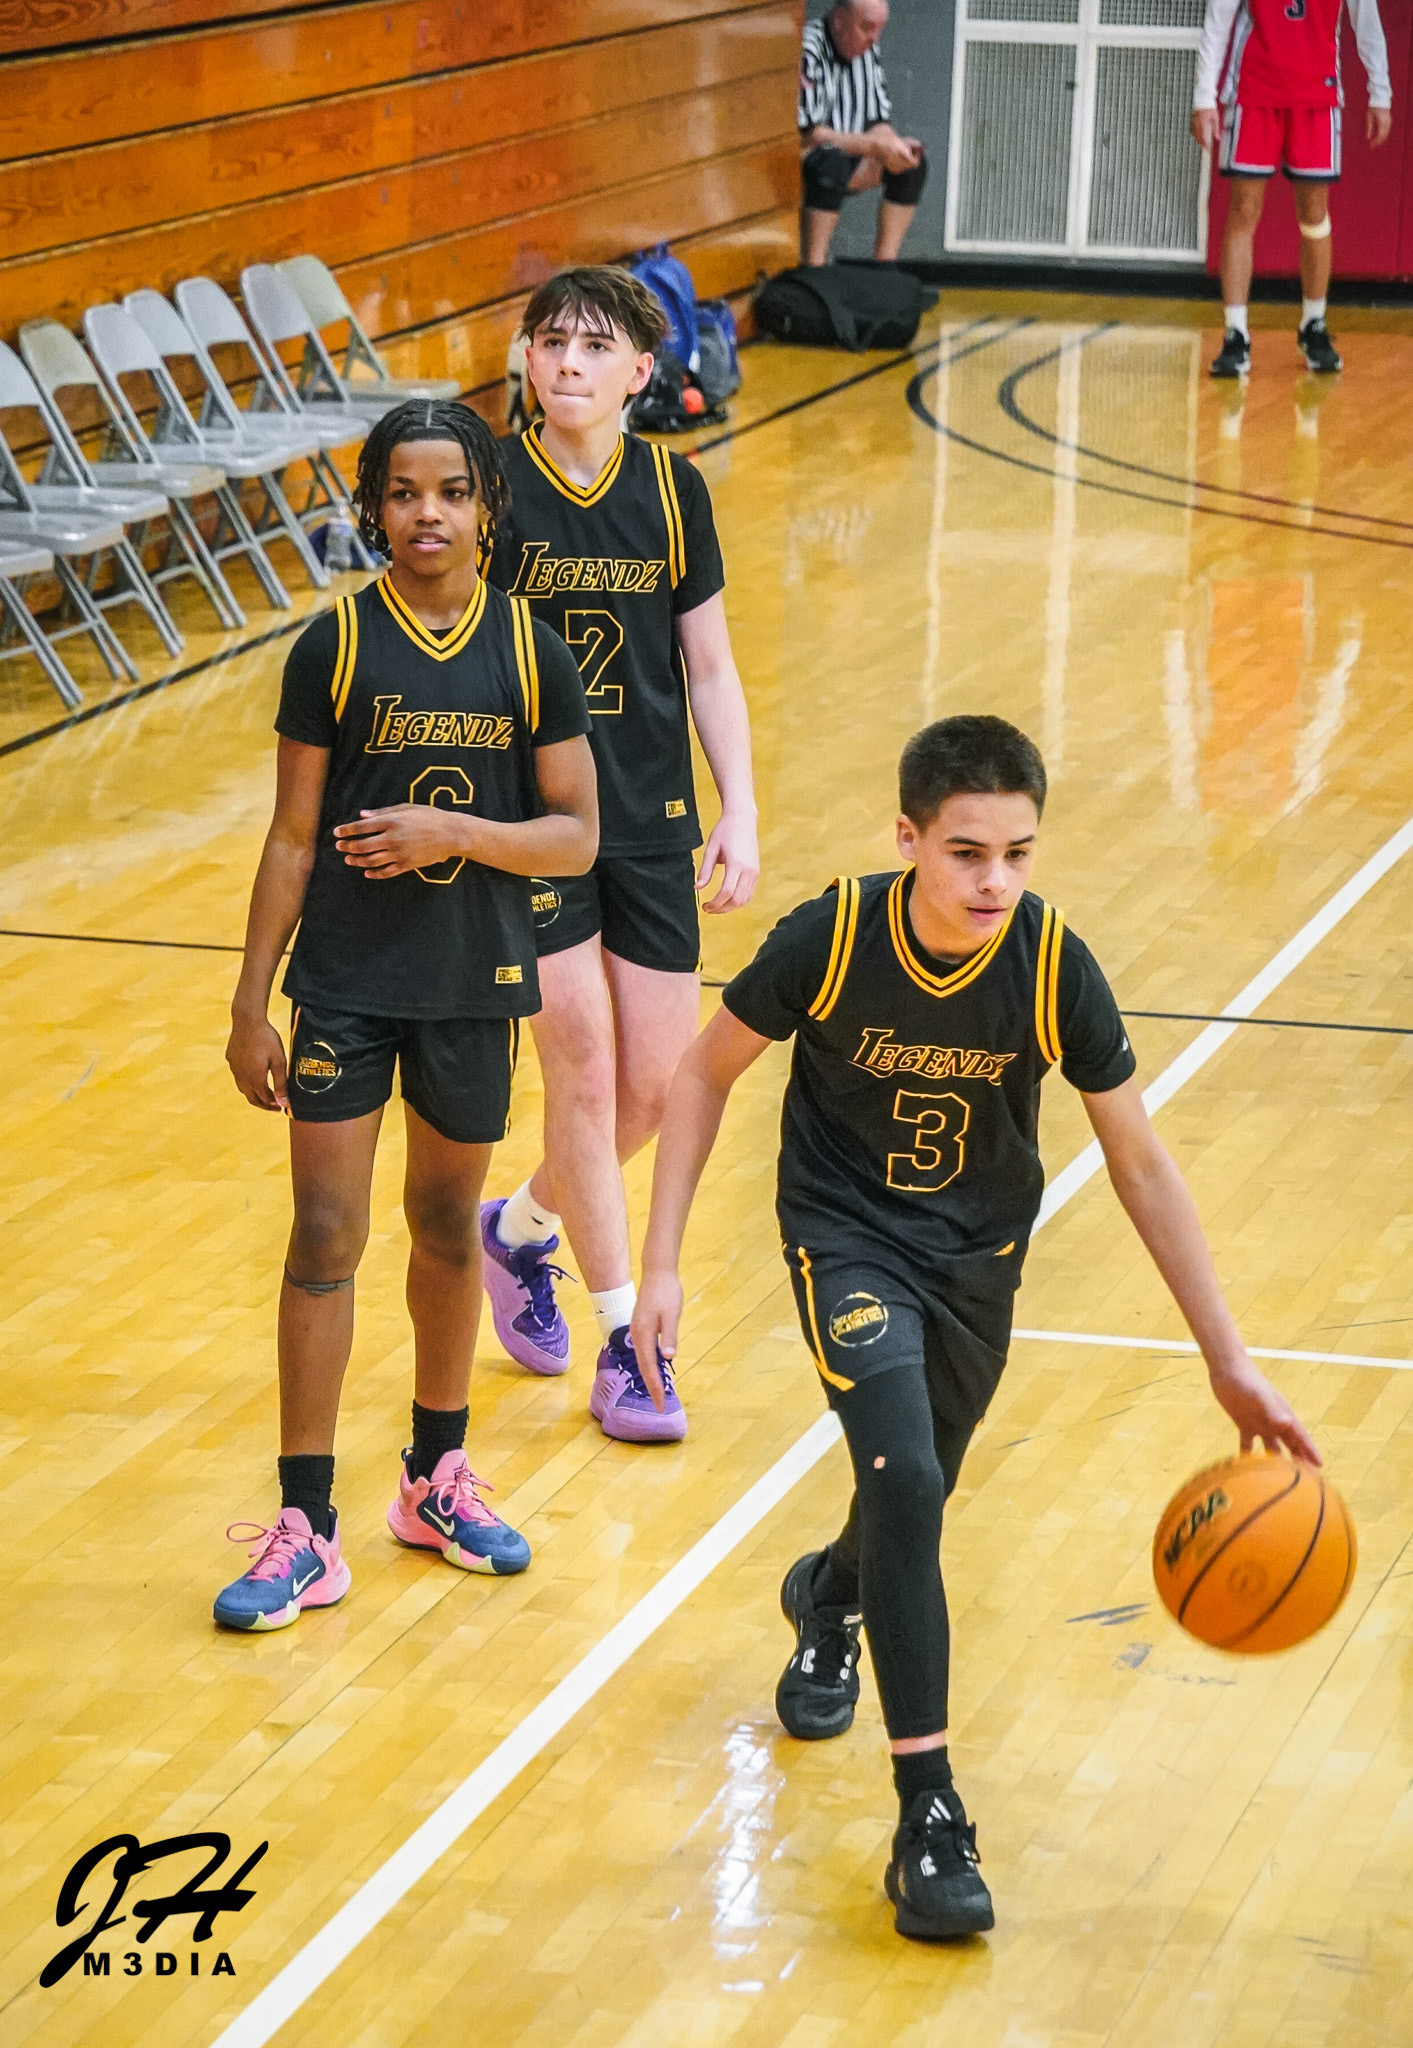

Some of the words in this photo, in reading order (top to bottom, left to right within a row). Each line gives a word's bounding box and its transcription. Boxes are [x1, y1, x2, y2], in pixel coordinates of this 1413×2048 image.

[507, 542, 666, 599] LEGENDZ
[564, 608, 624, 715] 2
[364, 694, 514, 753] LEGENDZ
[886, 1088, 970, 1192] 3
